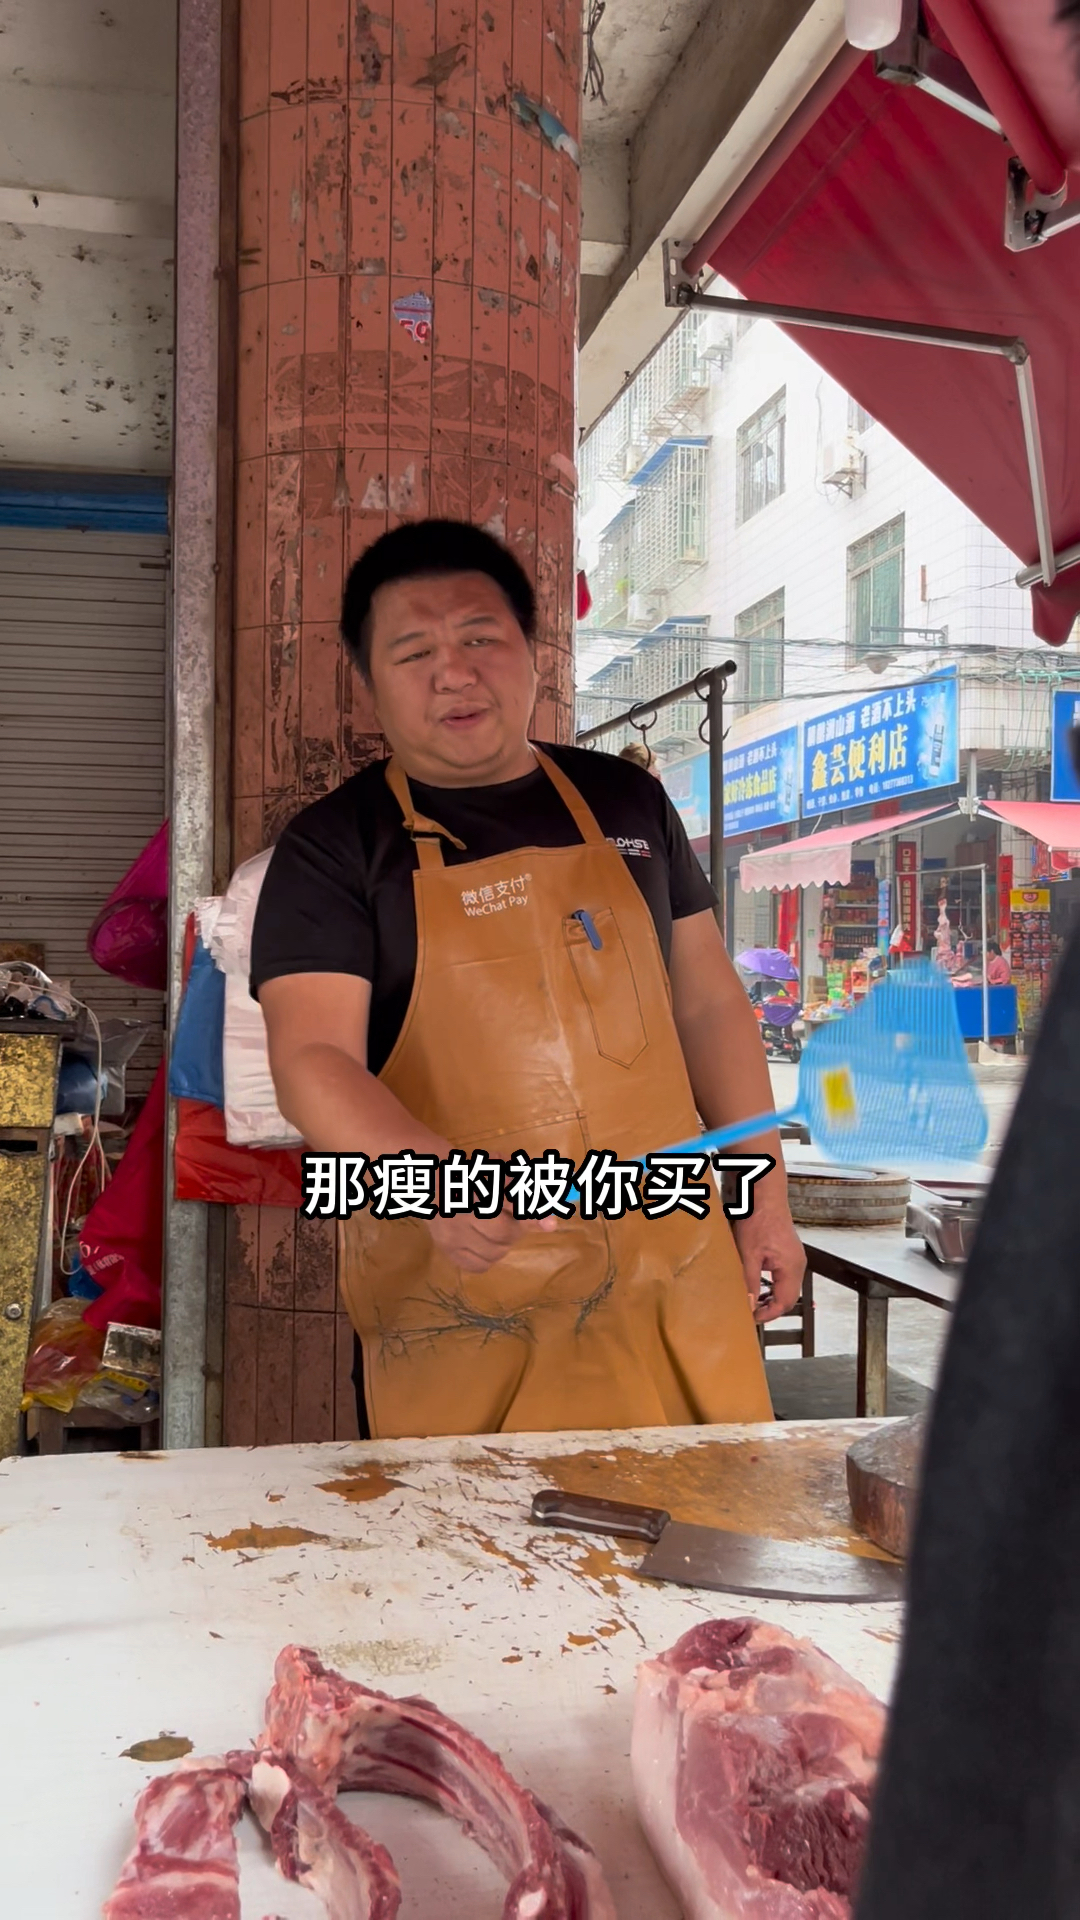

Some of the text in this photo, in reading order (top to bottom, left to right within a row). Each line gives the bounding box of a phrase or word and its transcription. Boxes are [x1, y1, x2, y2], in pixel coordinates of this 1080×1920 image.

[860, 687, 917, 730] 老酒不上头
[811, 723, 909, 792] 鑫芸便利店
[463, 894, 529, 918] WeChat Pay
